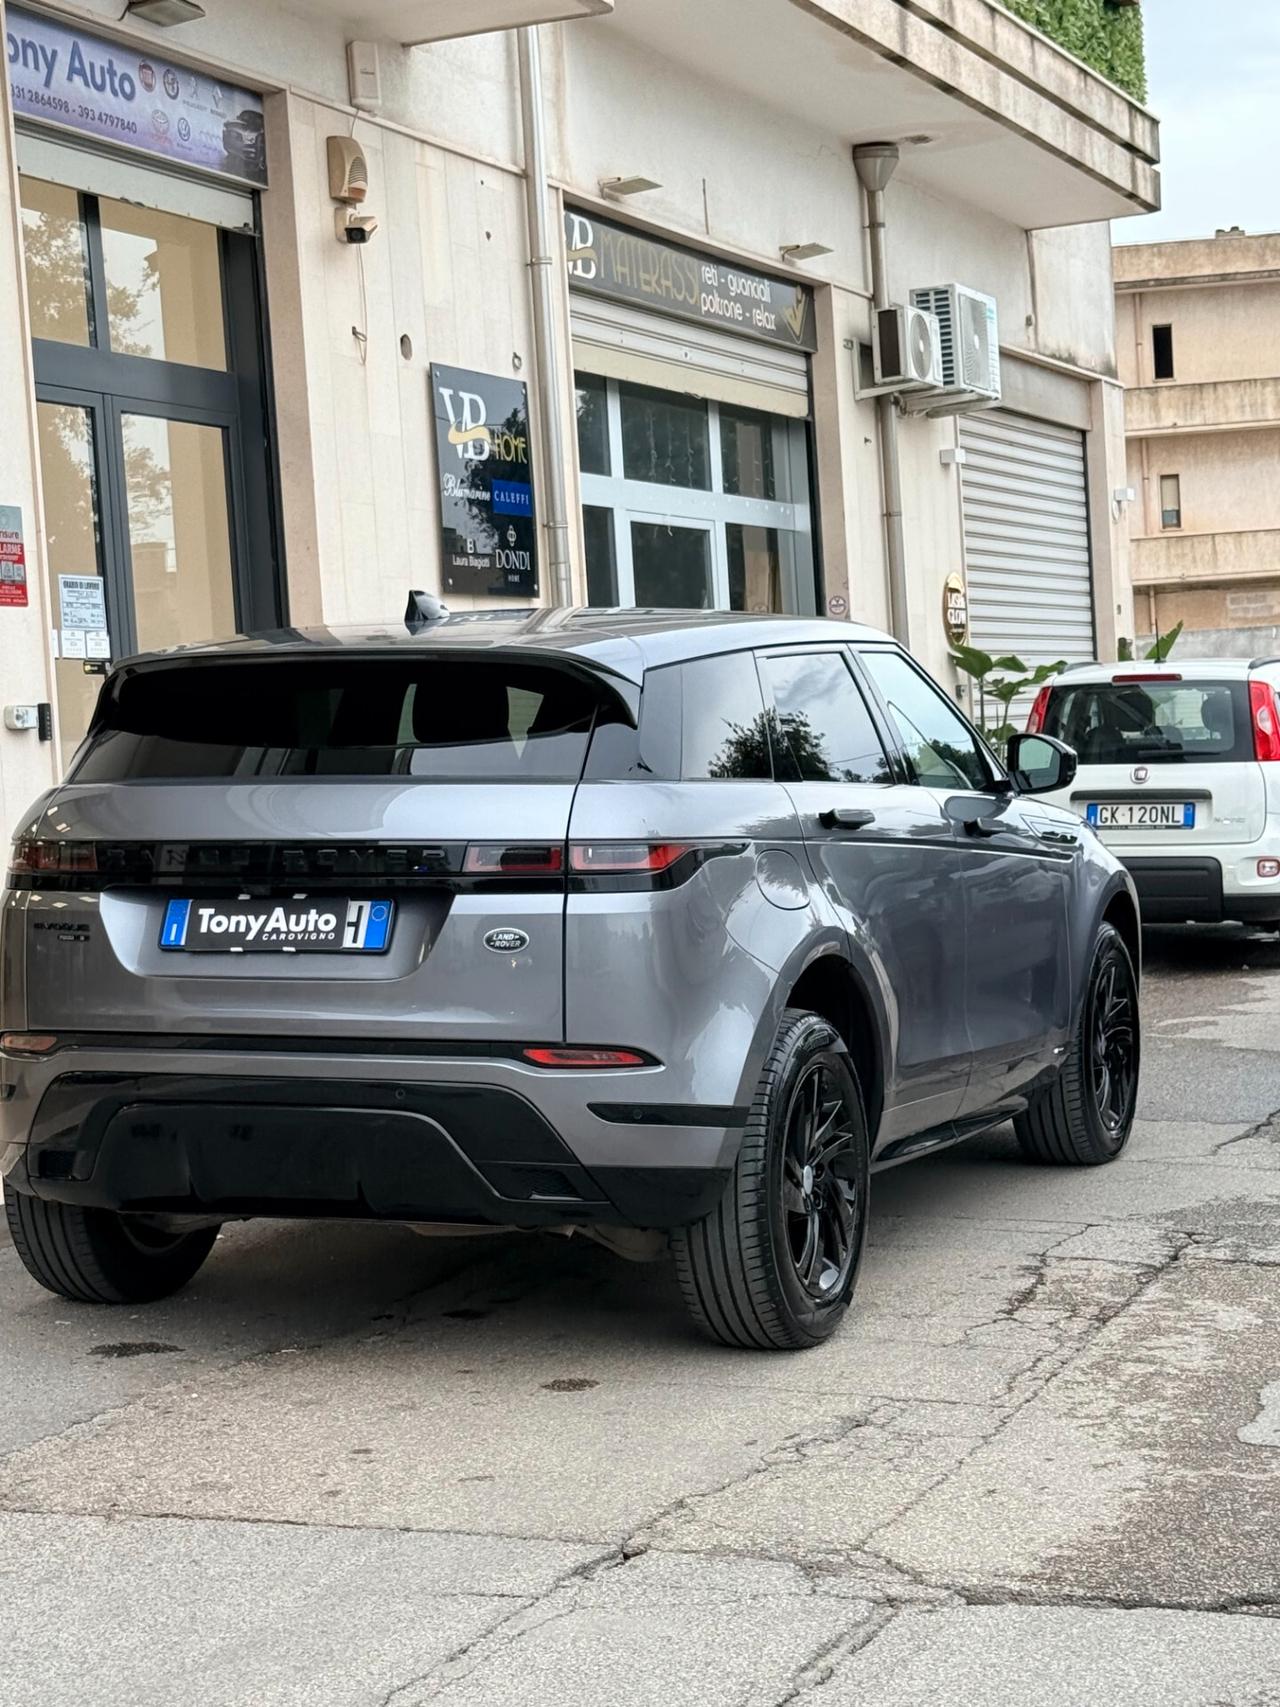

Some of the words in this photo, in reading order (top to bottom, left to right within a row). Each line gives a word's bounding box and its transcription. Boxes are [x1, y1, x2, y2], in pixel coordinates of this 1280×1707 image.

[66, 40, 136, 102] Auto
[28, 89, 70, 115] 2864598
[78, 105, 96, 121] 393
[98, 112, 138, 134] 4797840
[701, 265, 718, 287] reti
[727, 274, 771, 304] guanciali
[701, 289, 743, 321] poltrone
[752, 304, 776, 331] relax
[442, 472, 491, 501] Blumarine
[494, 490, 529, 505] CALEFFI
[452, 554, 468, 567] Laura
[495, 549, 531, 571] DONDI
[1099, 806, 1119, 824] GK
[1128, 806, 1181, 824] 120NL
[198, 906, 337, 941] TonyAuto
[262, 932, 336, 941] CAROVIGNO
[493, 933, 515, 941] LAND
[494, 940, 521, 948] ROVER
